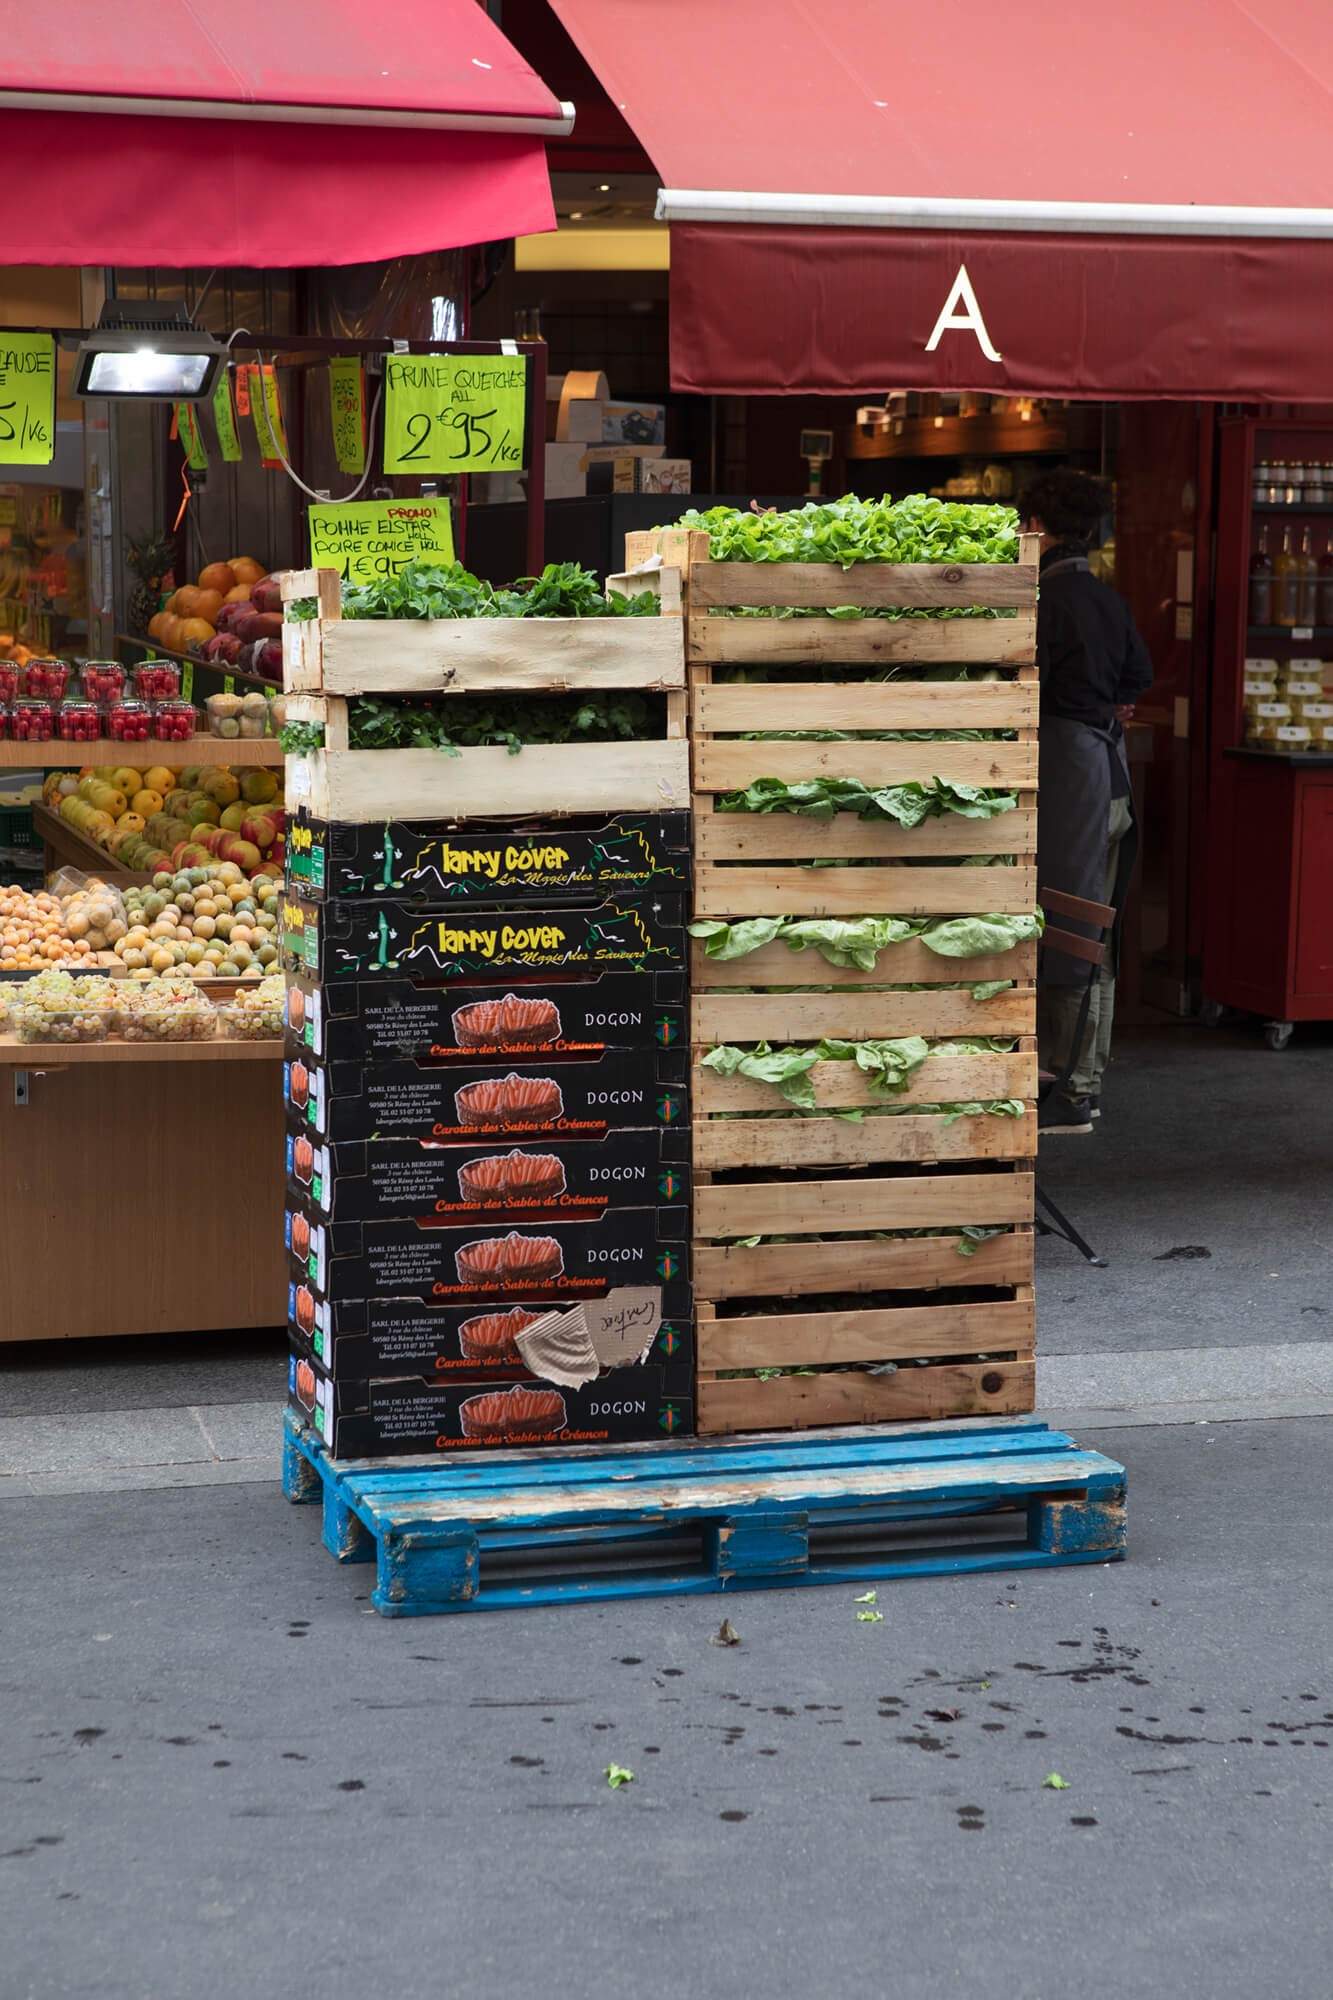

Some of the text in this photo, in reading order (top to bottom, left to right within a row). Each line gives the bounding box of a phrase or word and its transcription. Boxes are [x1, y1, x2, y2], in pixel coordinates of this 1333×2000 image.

[924, 263, 1003, 362] A
[388, 363, 525, 390] PRUNE QUETCHES
[387, 508, 438, 520] PROMO!
[378, 519, 435, 534] ELSTAR
[314, 540, 362, 555] POIRE
[497, 868, 650, 886] La Magie des Saveurs
[492, 948, 646, 965] La Magie des Saveurs
[585, 1012, 641, 1026] DOGON
[430, 1044, 476, 1056] Carottes
[478, 1044, 496, 1054] des
[500, 1042, 536, 1053] Sables
[538, 1041, 552, 1051] de
[587, 1090, 643, 1104] DOGON
[432, 1123, 478, 1135] Carottes
[481, 1123, 498, 1132] des
[502, 1120, 538, 1131] Sables
[541, 1120, 554, 1130] de
[590, 1167, 645, 1180] DOGON
[435, 1200, 480, 1212] Carottes
[483, 1199, 501, 1209] des
[504, 1197, 540, 1208] Sables
[544, 1196, 557, 1206] de
[588, 1248, 643, 1262] DOGON
[432, 1282, 478, 1294] Carottes
[481, 1282, 498, 1291] des
[502, 1280, 539, 1290] Sables
[541, 1279, 554, 1288] de
[435, 1357, 480, 1368] Carottes
[484, 1356, 501, 1366] des
[590, 1401, 646, 1415] DOGON
[436, 1436, 482, 1447] Carottes
[484, 1434, 502, 1444] des
[505, 1432, 540, 1443] Sables
[544, 1431, 557, 1440] de
